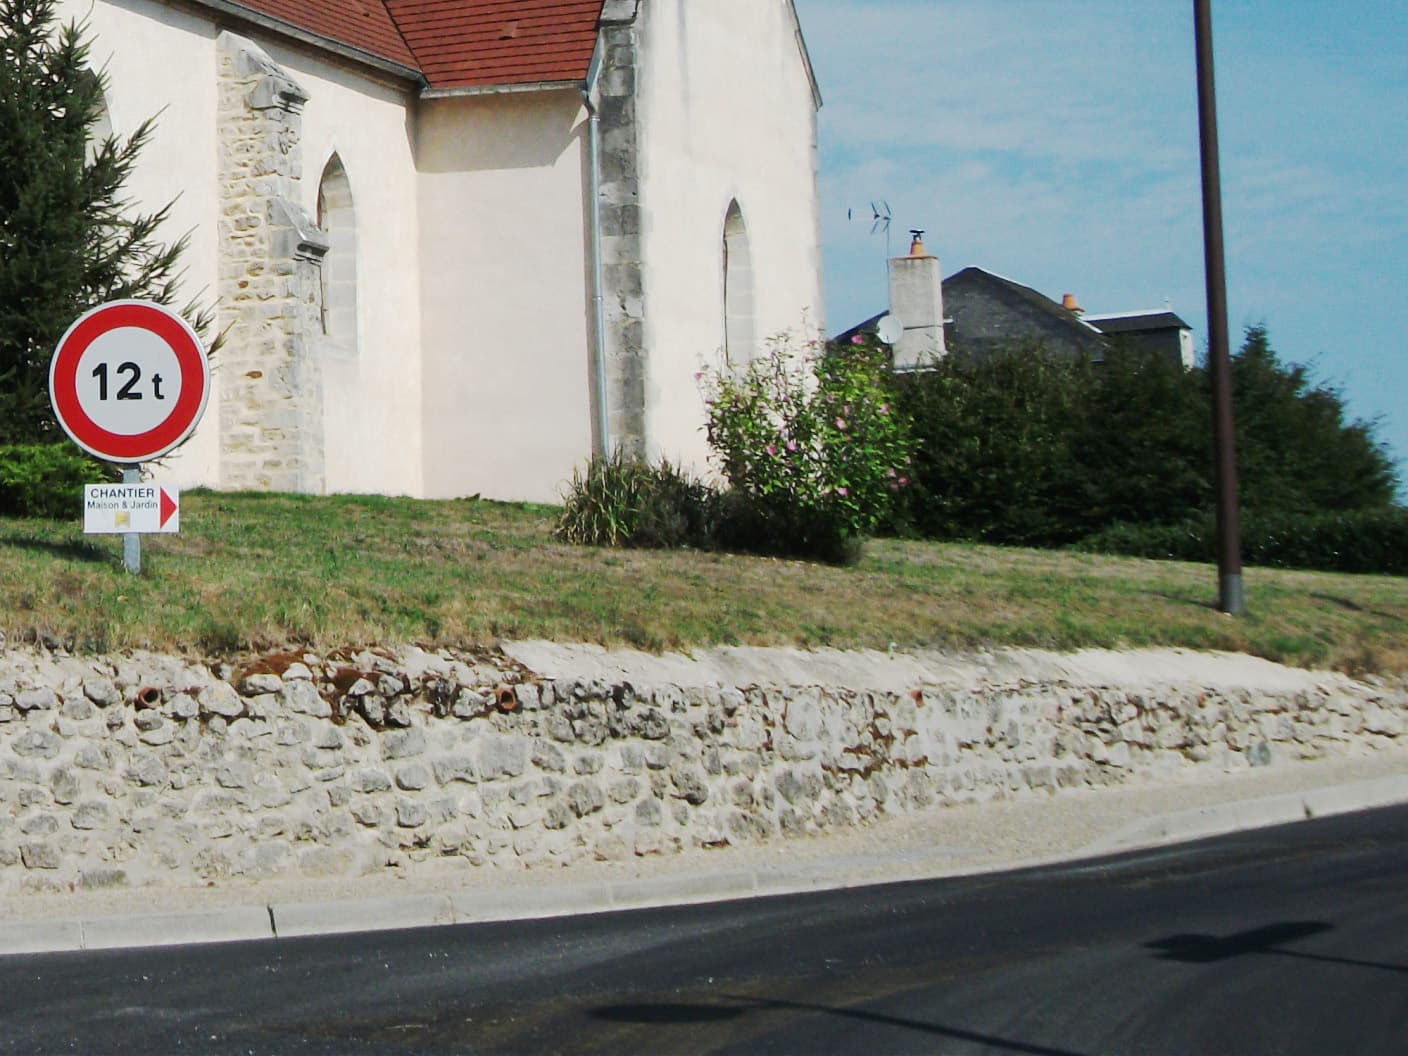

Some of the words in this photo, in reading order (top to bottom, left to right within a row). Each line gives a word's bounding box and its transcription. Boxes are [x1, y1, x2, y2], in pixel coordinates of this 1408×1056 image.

[92, 361, 143, 401] 12
[151, 373, 165, 400] t
[90, 488, 155, 499] CHANTIER
[87, 500, 119, 509] Maison
[121, 500, 128, 509] &
[131, 500, 158, 509] Jardin
